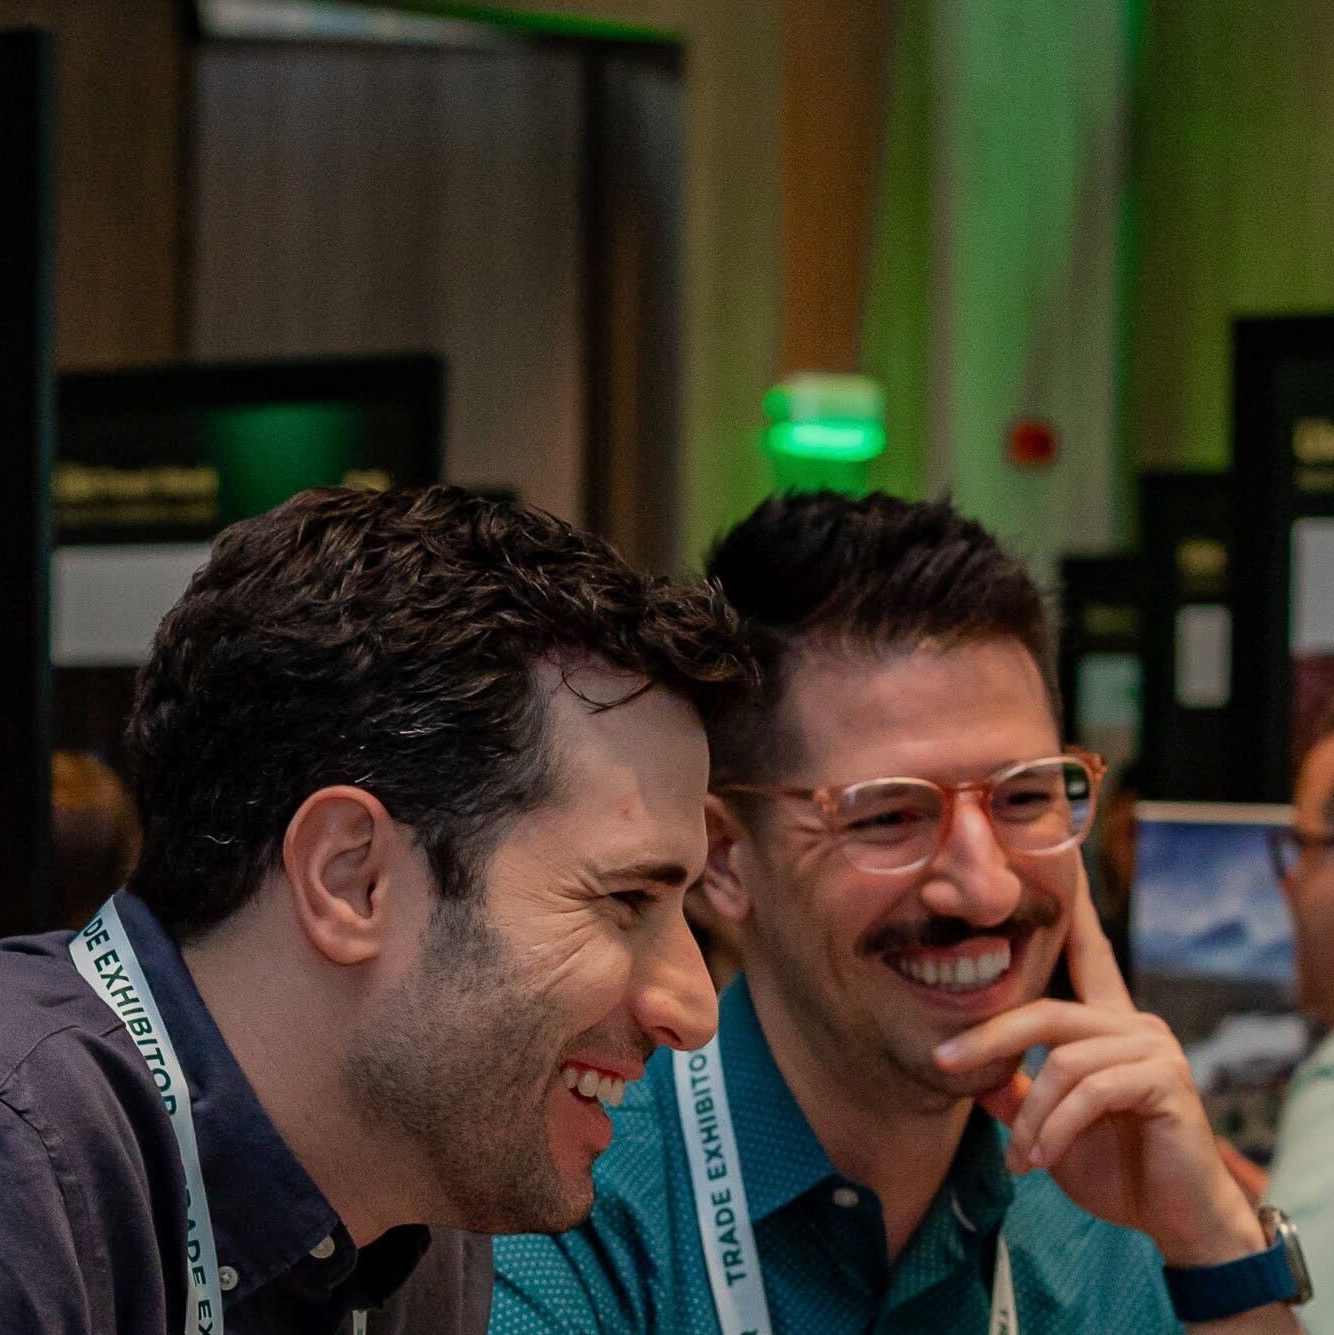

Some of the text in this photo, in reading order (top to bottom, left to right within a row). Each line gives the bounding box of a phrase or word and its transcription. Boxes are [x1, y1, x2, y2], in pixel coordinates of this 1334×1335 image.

[186, 1188, 207, 1287] ADE
[688, 1051, 747, 1288] TRADE EXHIBITO
